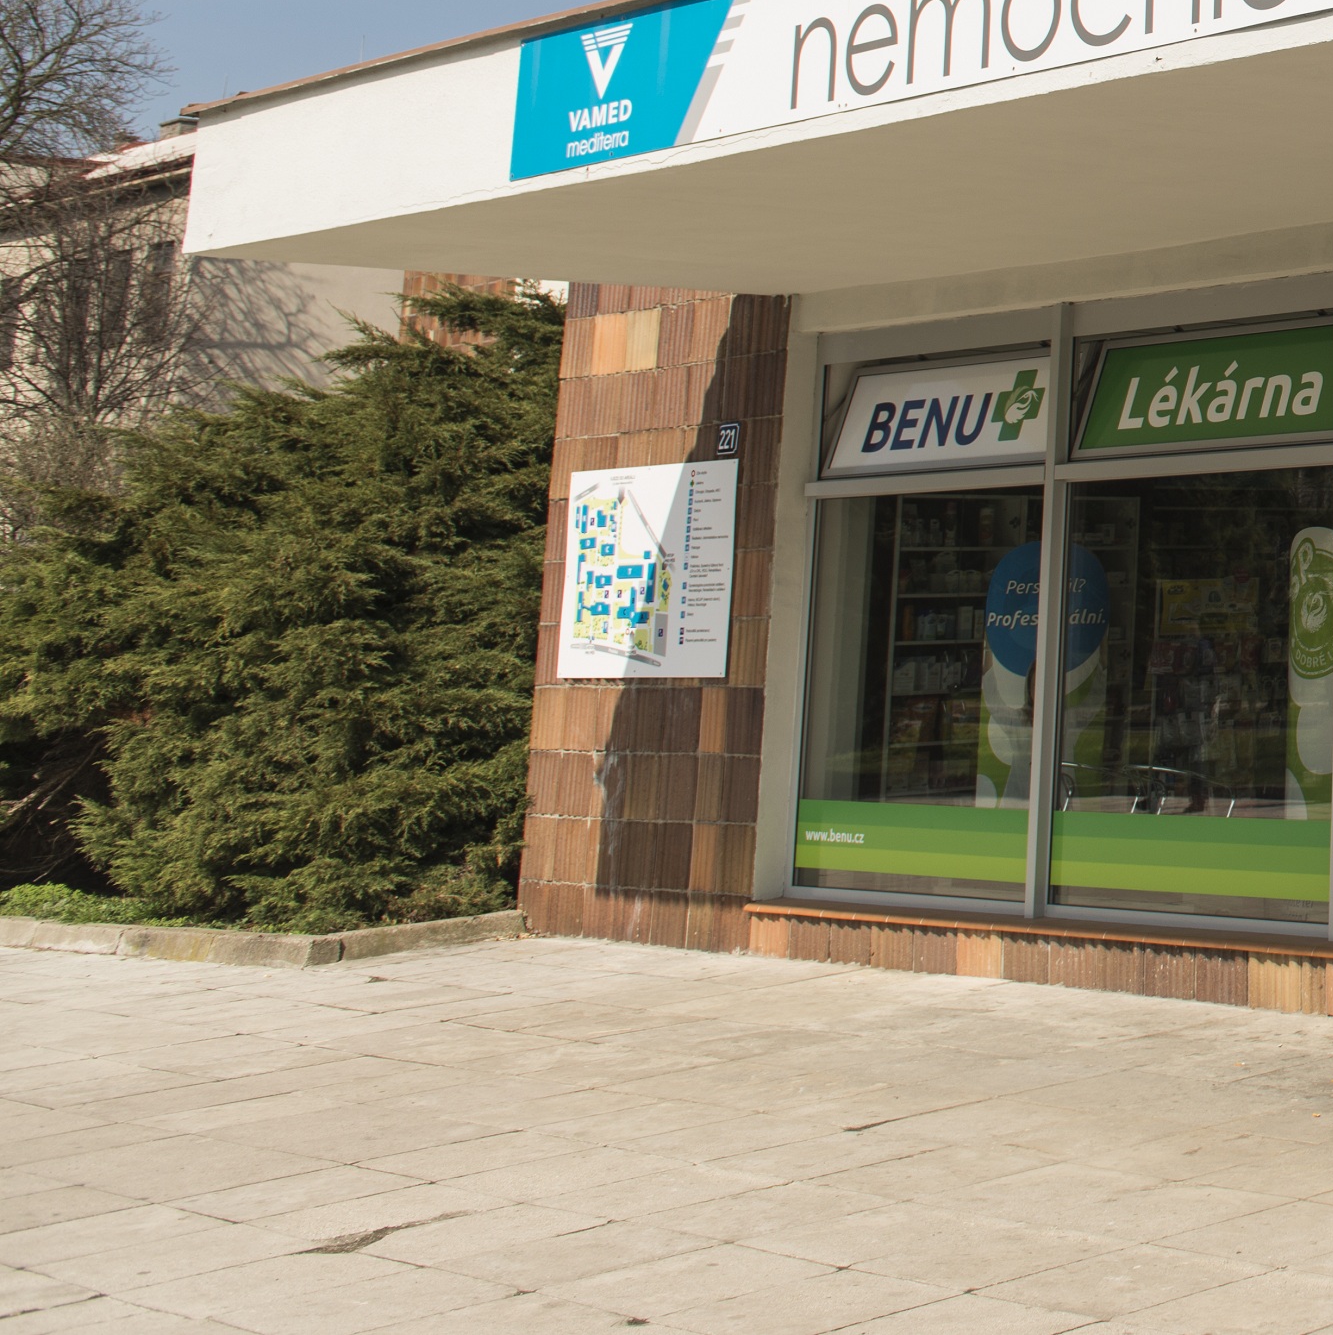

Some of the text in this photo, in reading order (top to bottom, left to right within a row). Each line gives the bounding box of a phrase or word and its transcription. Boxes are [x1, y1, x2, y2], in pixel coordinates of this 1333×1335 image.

[567, 98, 633, 133] VAMED
[565, 130, 630, 158] mediterra
[1117, 360, 1326, 432] Lékárna
[860, 392, 994, 453] BENU
[718, 428, 736, 450] 221
[1295, 648, 1327, 667] DOBRÉ
[805, 828, 865, 844] www.benu.cz
